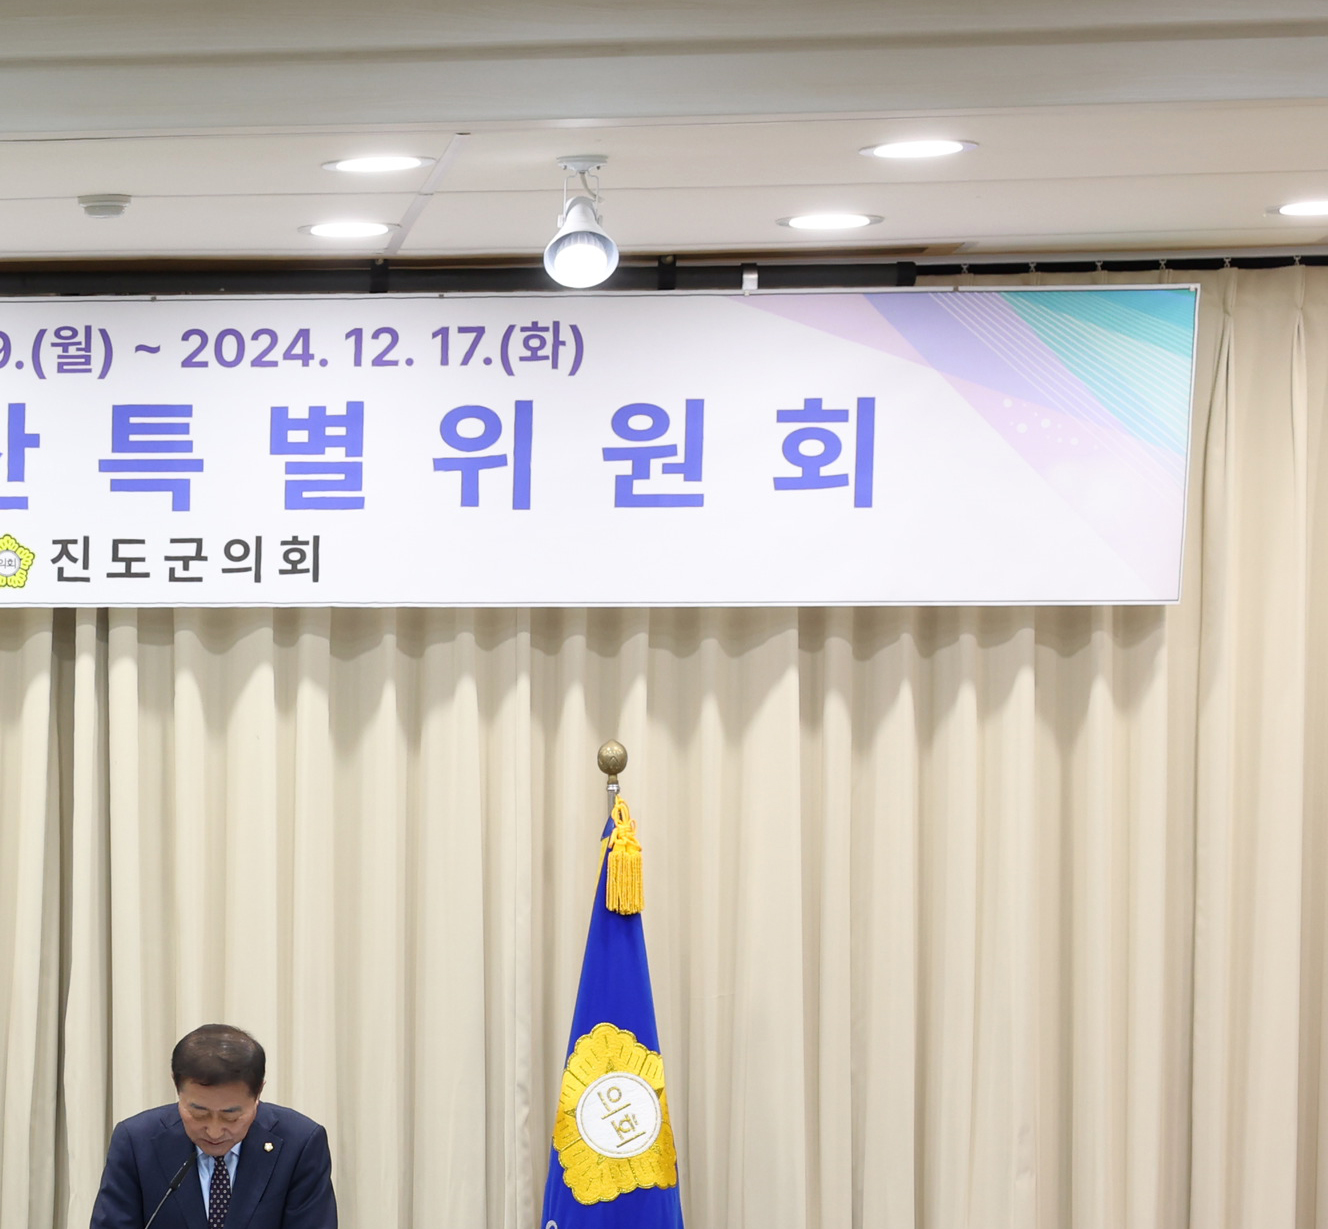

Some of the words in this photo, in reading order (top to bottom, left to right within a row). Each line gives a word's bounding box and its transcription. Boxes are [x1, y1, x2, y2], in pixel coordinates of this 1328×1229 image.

[180, 327, 329, 369] 2024.
[344, 326, 415, 368] 12.
[431, 320, 585, 377] 17.(화)
[50, 535, 320, 583] 진도군의회
[596, 1085, 647, 1149] 의회
